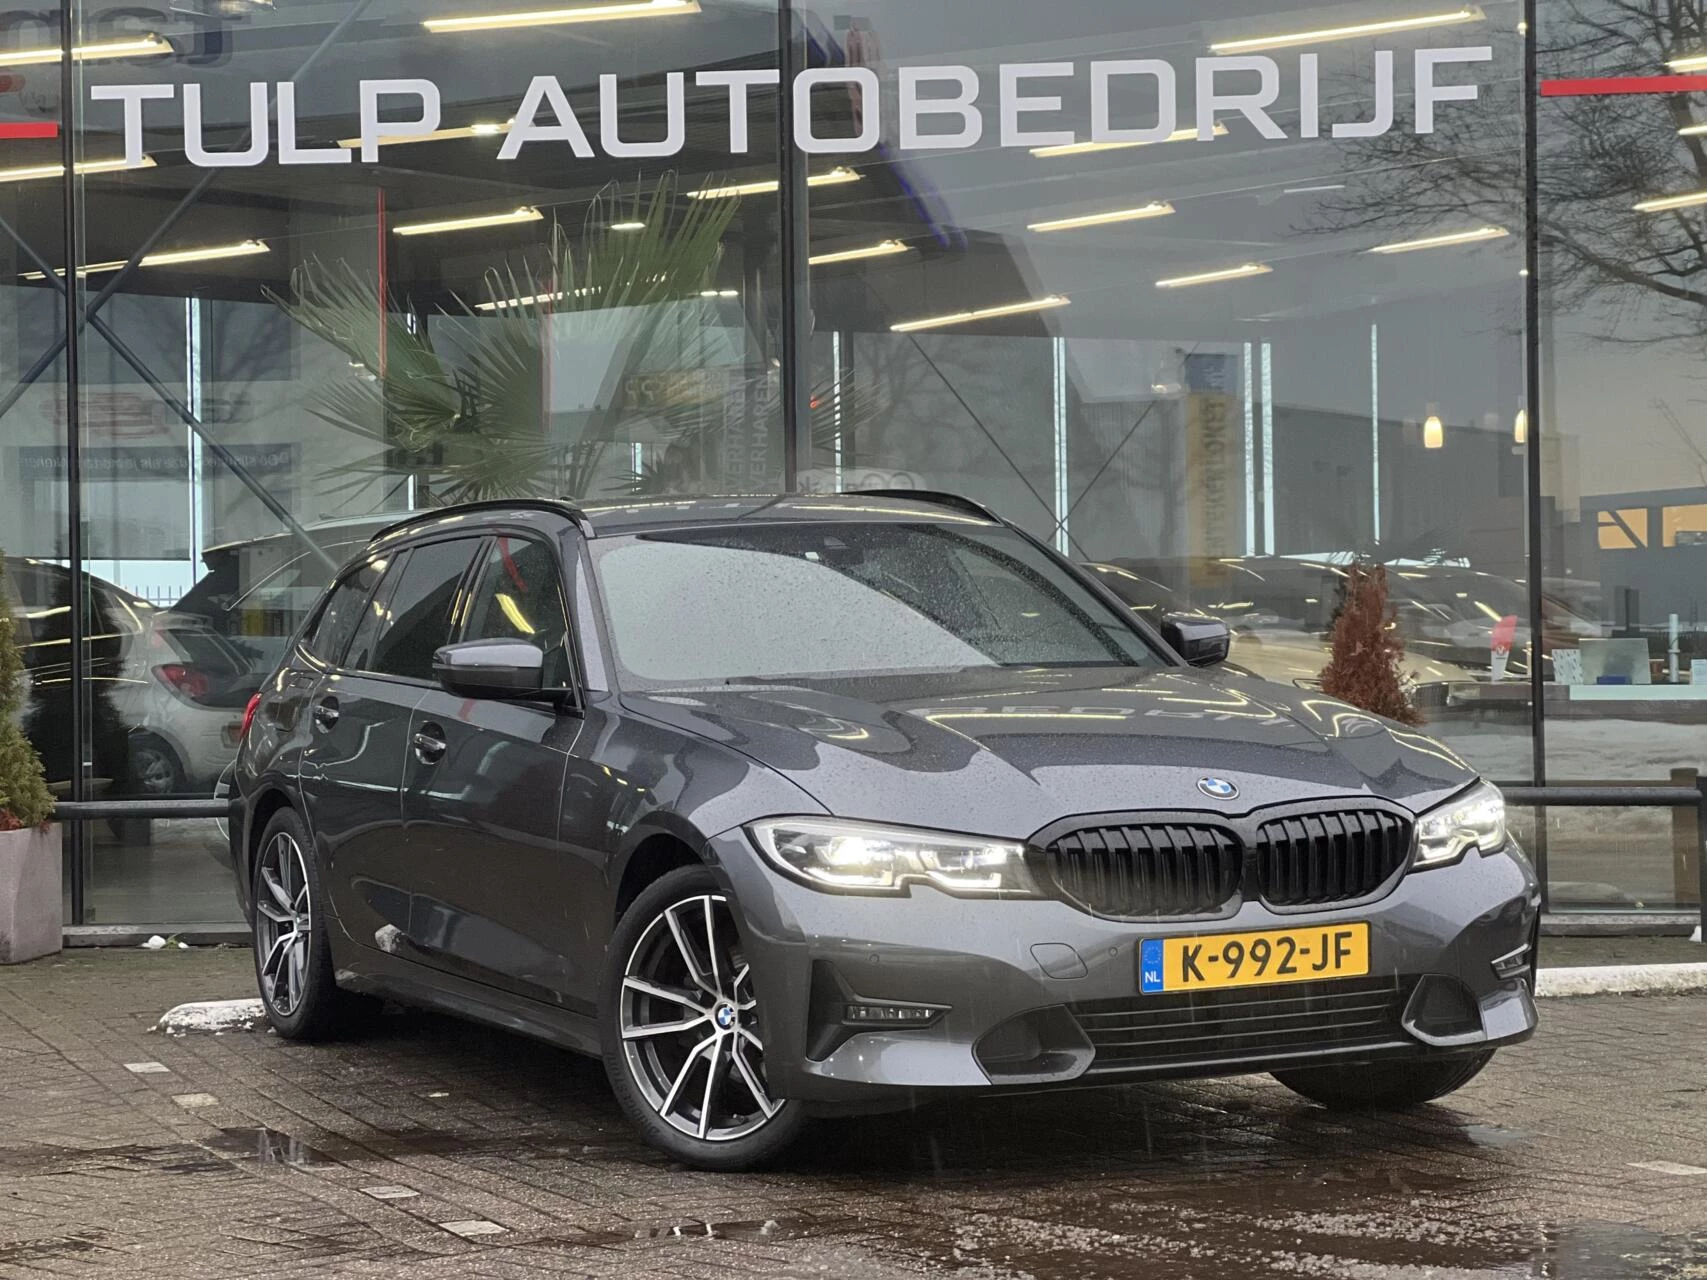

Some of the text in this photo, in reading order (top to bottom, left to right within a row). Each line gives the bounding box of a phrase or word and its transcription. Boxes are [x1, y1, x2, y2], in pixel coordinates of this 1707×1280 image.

[91, 46, 1493, 168] TULP AUTOBEDRIJF
[1144, 971, 1161, 984] NL
[1182, 931, 1353, 983] K-992-JF
